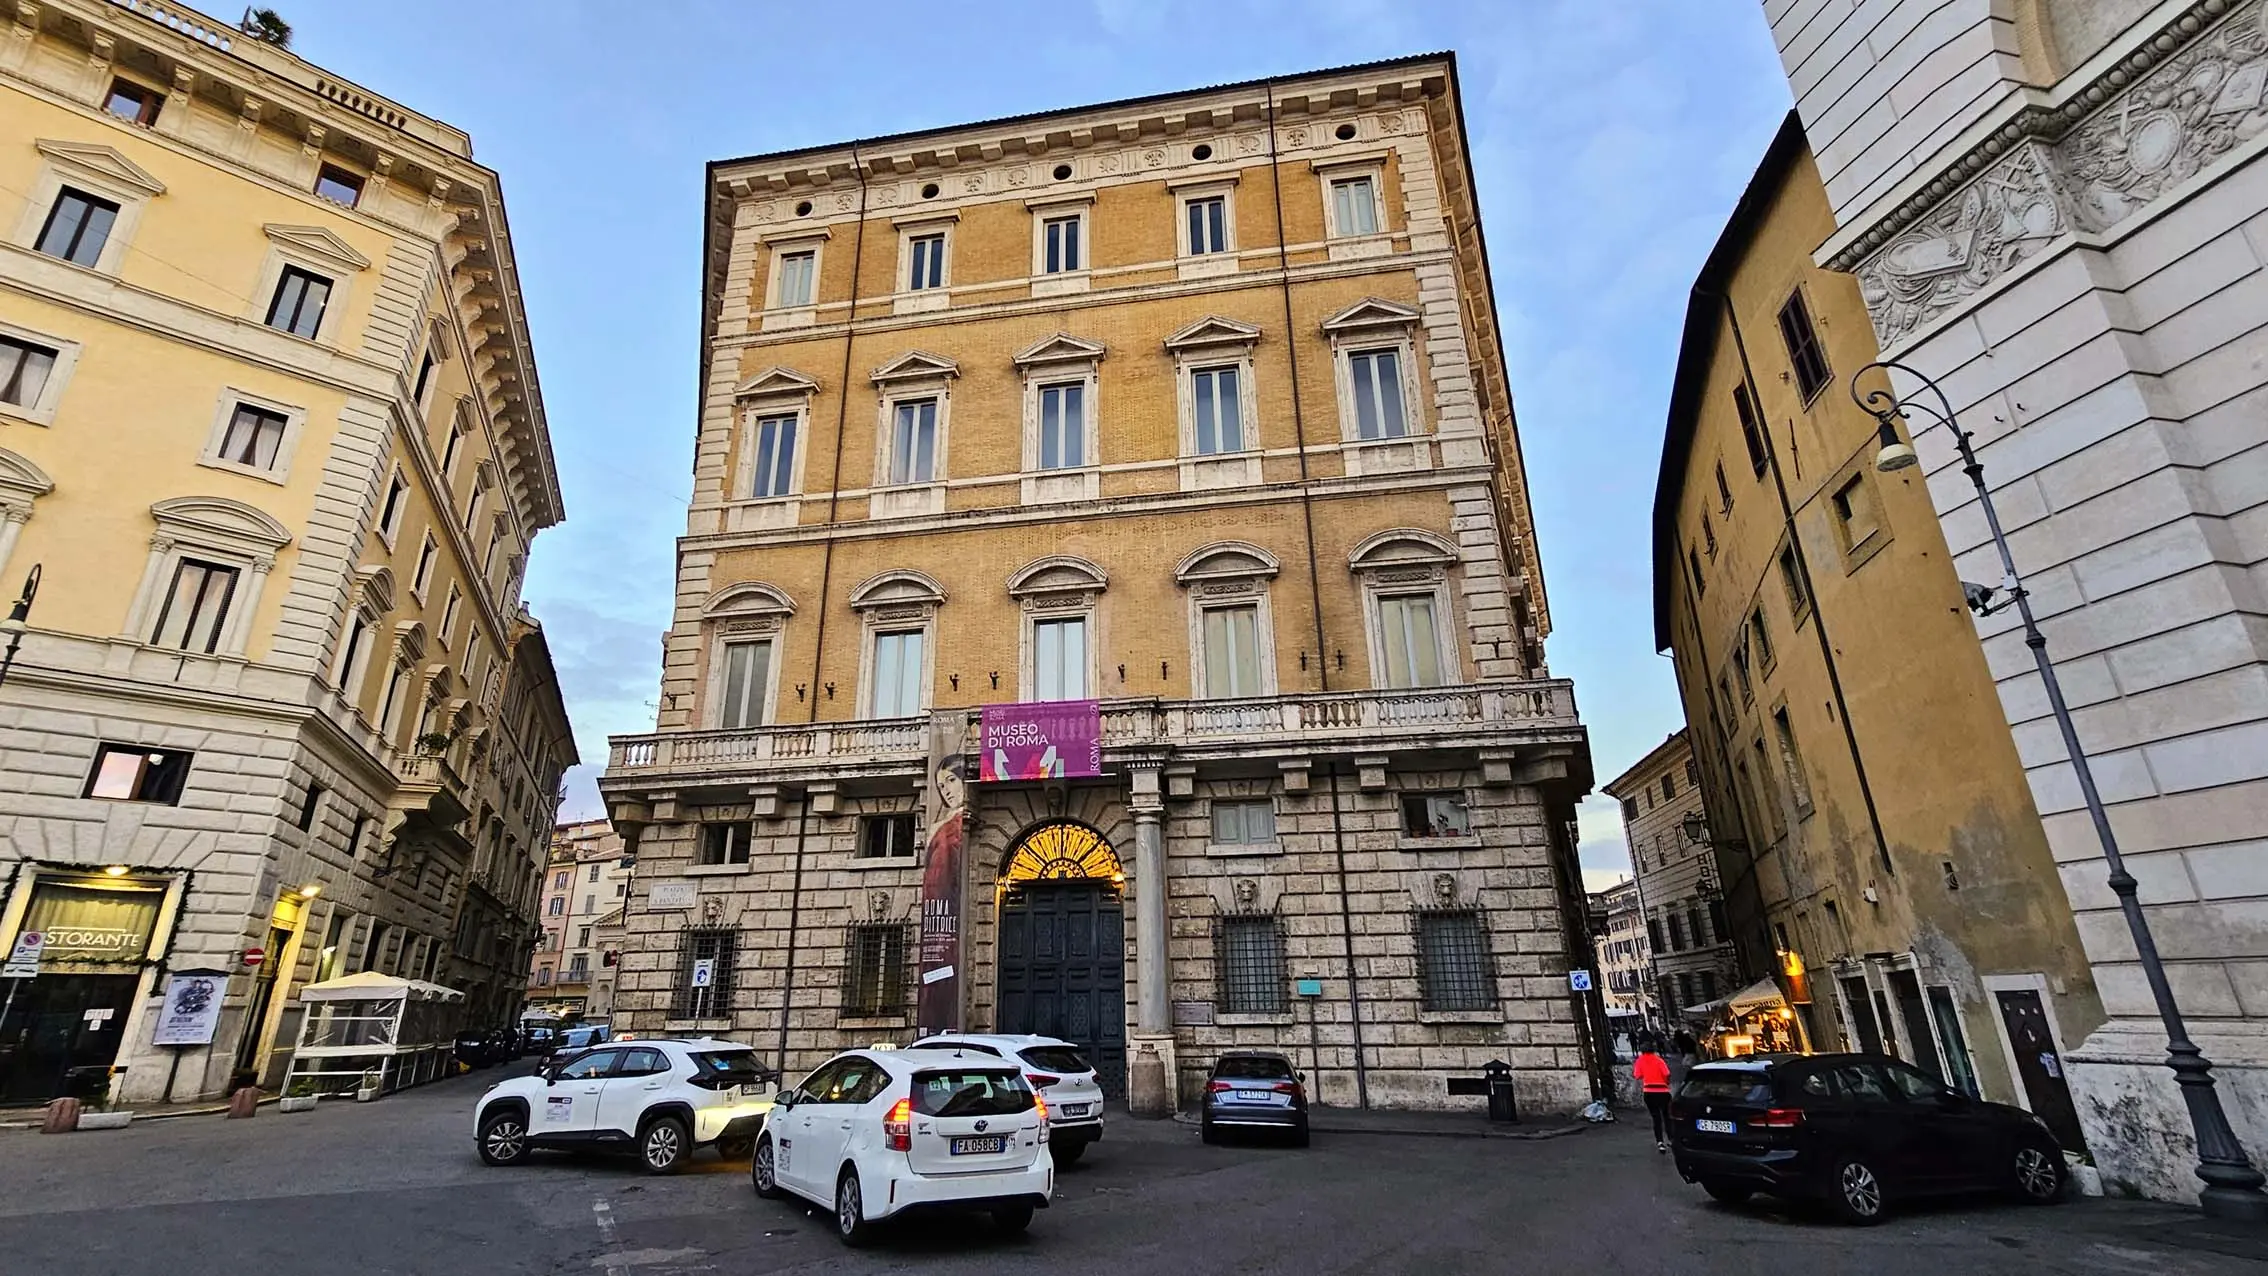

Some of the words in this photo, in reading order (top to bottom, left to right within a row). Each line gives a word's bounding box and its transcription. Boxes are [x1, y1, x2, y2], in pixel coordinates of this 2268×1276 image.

[988, 724, 1038, 737] MUSEO
[988, 737, 1002, 748] DI
[1006, 734, 1049, 747] ROMA
[1089, 738, 1100, 772] ROMA
[924, 899, 949, 916] ROMA
[923, 916, 957, 933] PITTRICE
[45, 932, 139, 947] STORANTE
[957, 1139, 969, 1153] FA
[971, 1137, 999, 1152] 058CB
